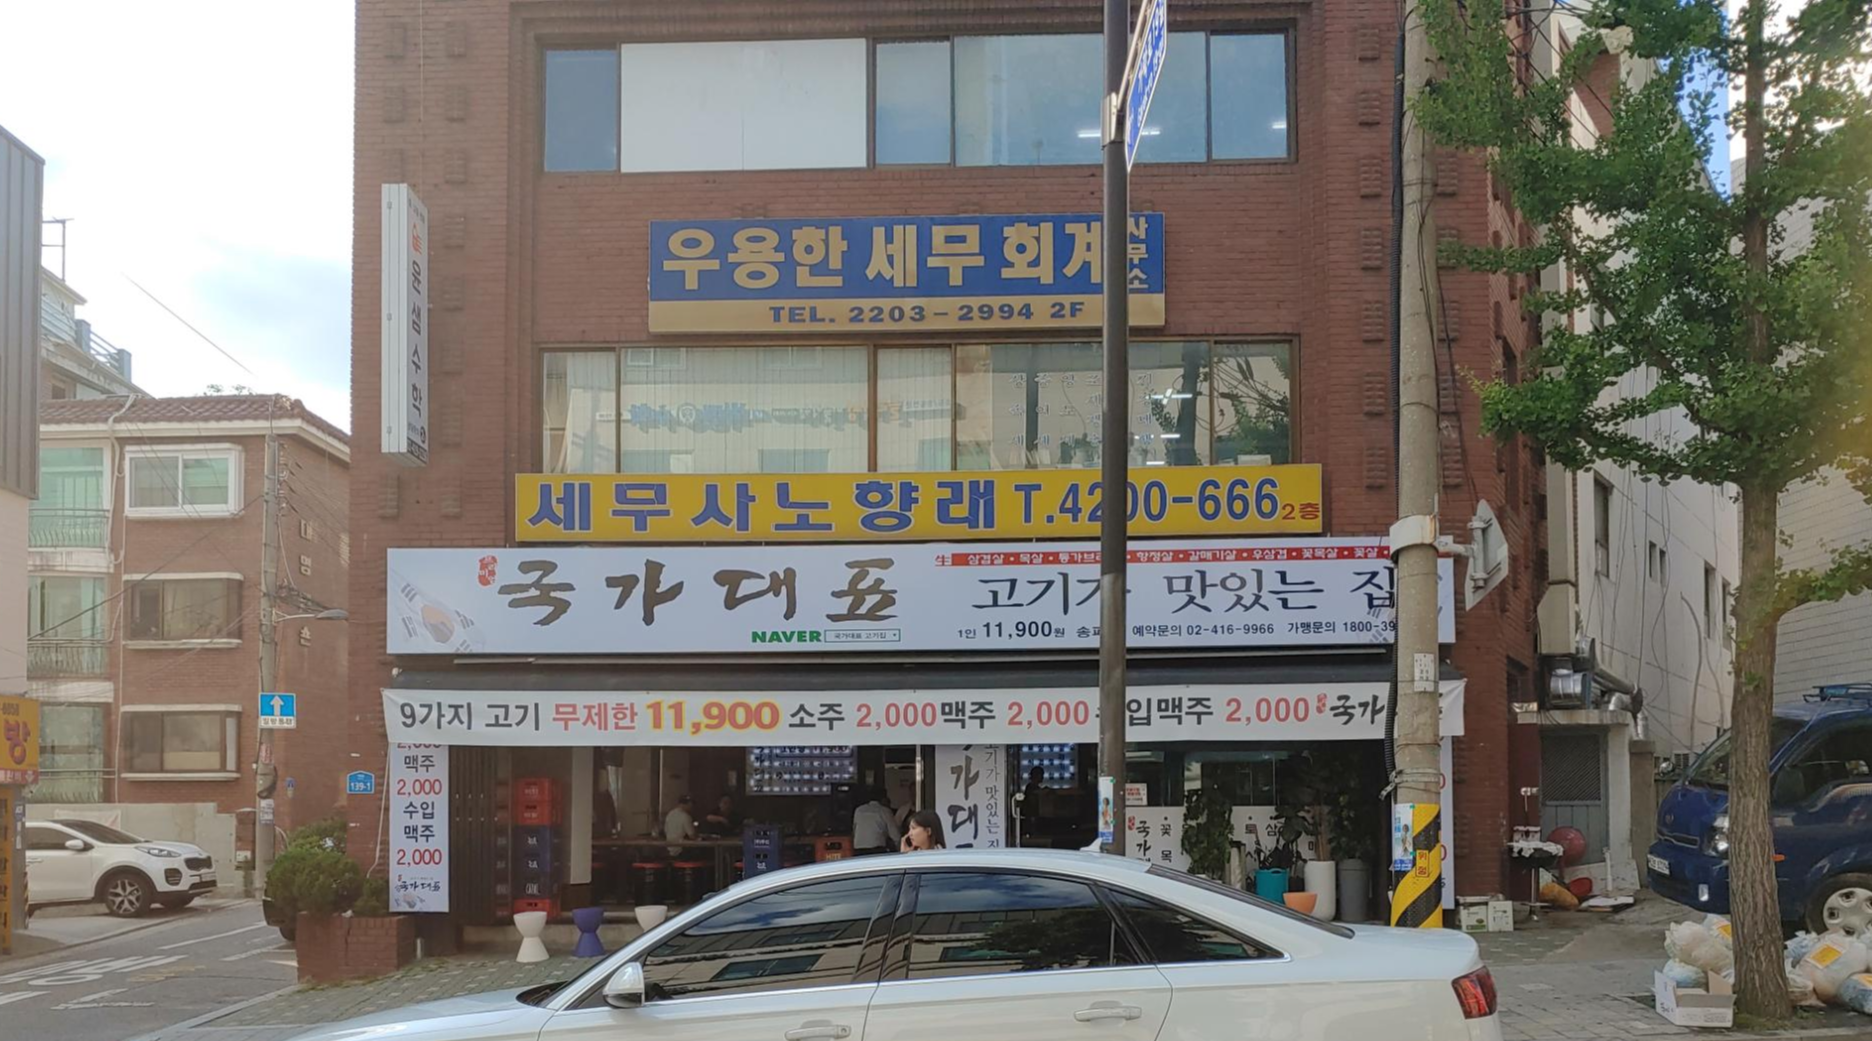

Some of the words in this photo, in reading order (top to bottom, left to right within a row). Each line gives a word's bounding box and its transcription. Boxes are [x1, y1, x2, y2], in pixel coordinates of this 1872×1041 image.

[663, 225, 848, 290] 우용한
[865, 223, 985, 288] 세무
[1000, 221, 1102, 285] 회계
[769, 306, 836, 323] TEL.
[848, 302, 1034, 322] 2203-2994
[1050, 301, 1085, 319] 2F
[1281, 501, 1320, 520] 2층
[967, 553, 1005, 565] 삼겹살
[1019, 553, 1044, 564] 목살
[1058, 551, 1102, 563] 통가브
[1136, 551, 1174, 563] 항정살
[1188, 550, 1238, 562] 갈매기살
[1252, 549, 1288, 560] 우삼겹
[1354, 548, 1378, 559] 꽃살
[498, 558, 898, 627] 국가대표
[1163, 568, 1325, 614] 맛있는
[1349, 566, 1396, 610] 집
[751, 631, 821, 643] NAVER
[958, 629, 977, 639] 1인
[1132, 625, 1182, 637] 예약문의
[1186, 624, 1275, 636] 02-416-9966
[1287, 621, 1336, 634] 가맹문의
[1343, 621, 1397, 633] 1800-39
[400, 701, 472, 730] 9가지
[485, 702, 540, 730] 고기
[552, 702, 638, 731] 무제한
[646, 699, 781, 735] 11,900
[788, 703, 845, 730] 소주
[856, 703, 937, 730] 2,000
[940, 701, 996, 729] 맥주
[1007, 700, 1090, 729] 2,000
[1225, 697, 1310, 726] 2,000
[1329, 694, 1386, 725] 국가
[404, 754, 435, 773] 맥주
[397, 778, 442, 797] 2,000
[947, 744, 980, 849] 가대
[403, 801, 435, 820] 수입
[404, 825, 435, 843] 맥주
[397, 848, 442, 868] 2,000
